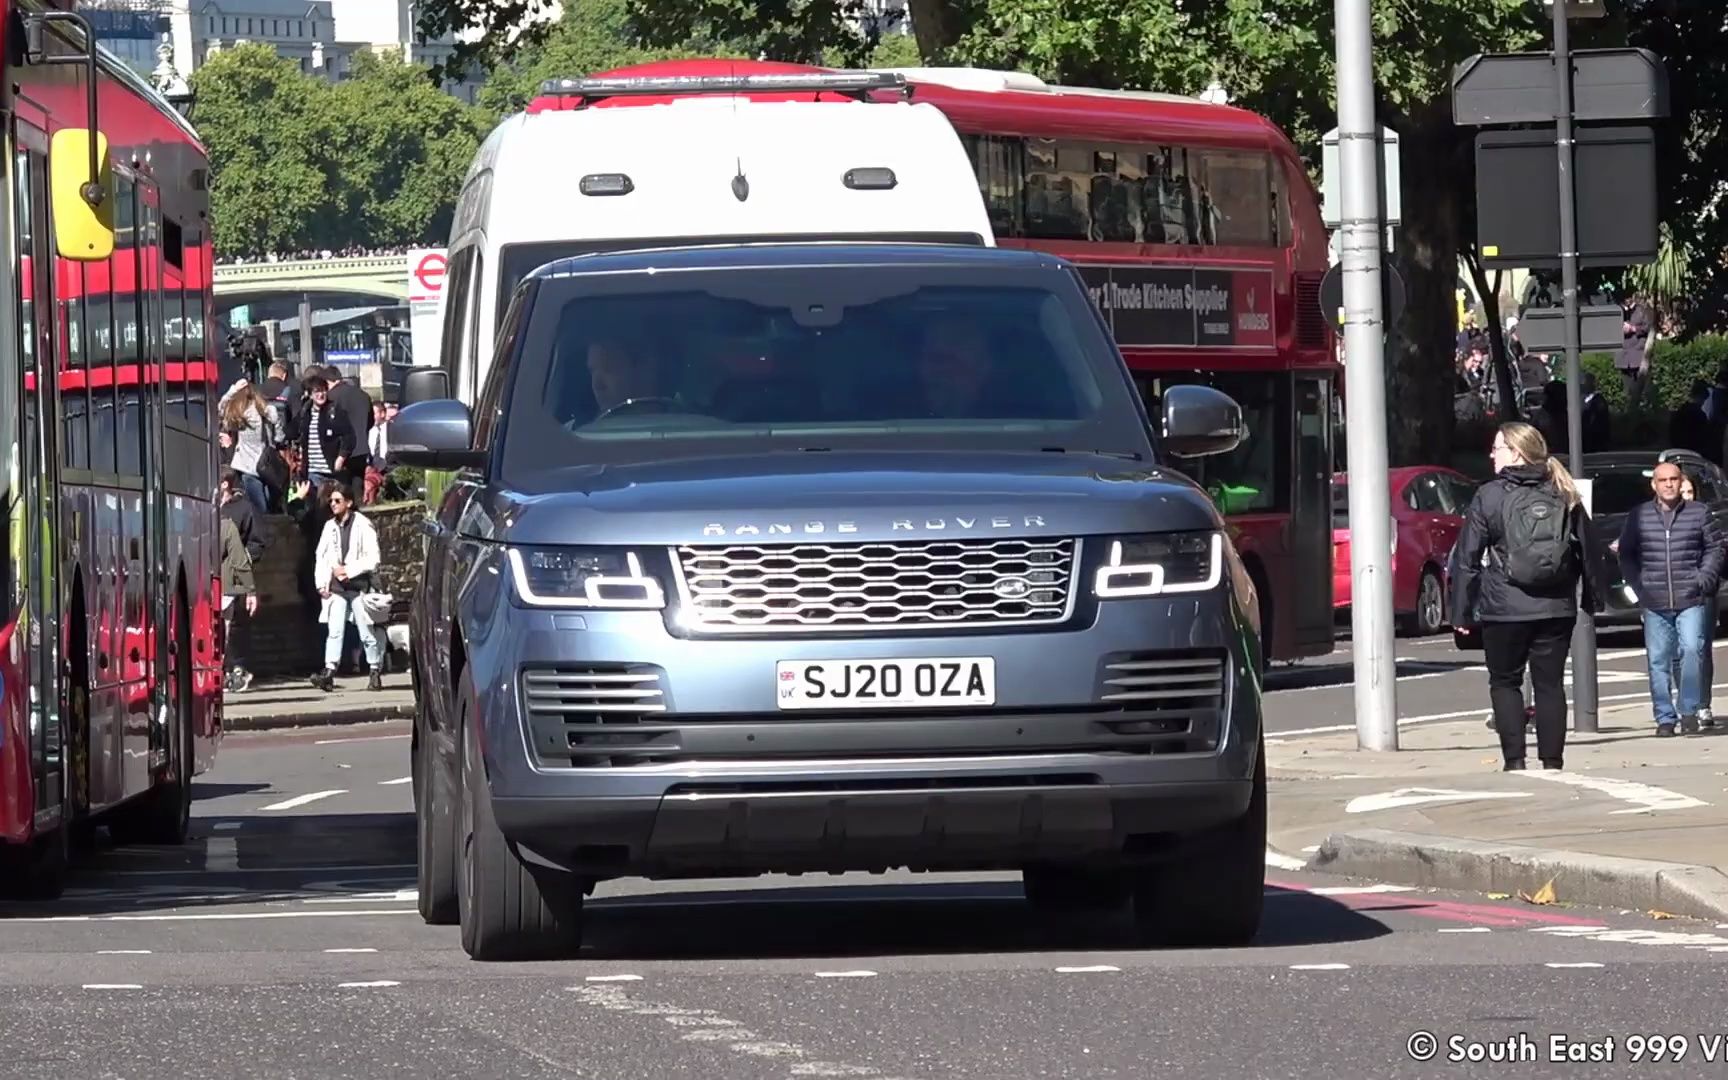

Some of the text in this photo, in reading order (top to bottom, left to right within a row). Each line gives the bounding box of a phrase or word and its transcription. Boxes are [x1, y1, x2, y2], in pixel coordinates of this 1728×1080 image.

[1111, 282, 1142, 309] Trade
[1143, 283, 1183, 309] Kitchen
[1184, 283, 1228, 315] Supplier
[703, 515, 1046, 536] RANGE ROVER
[780, 687, 796, 699] UK
[804, 662, 986, 699] SJ20 OZA
